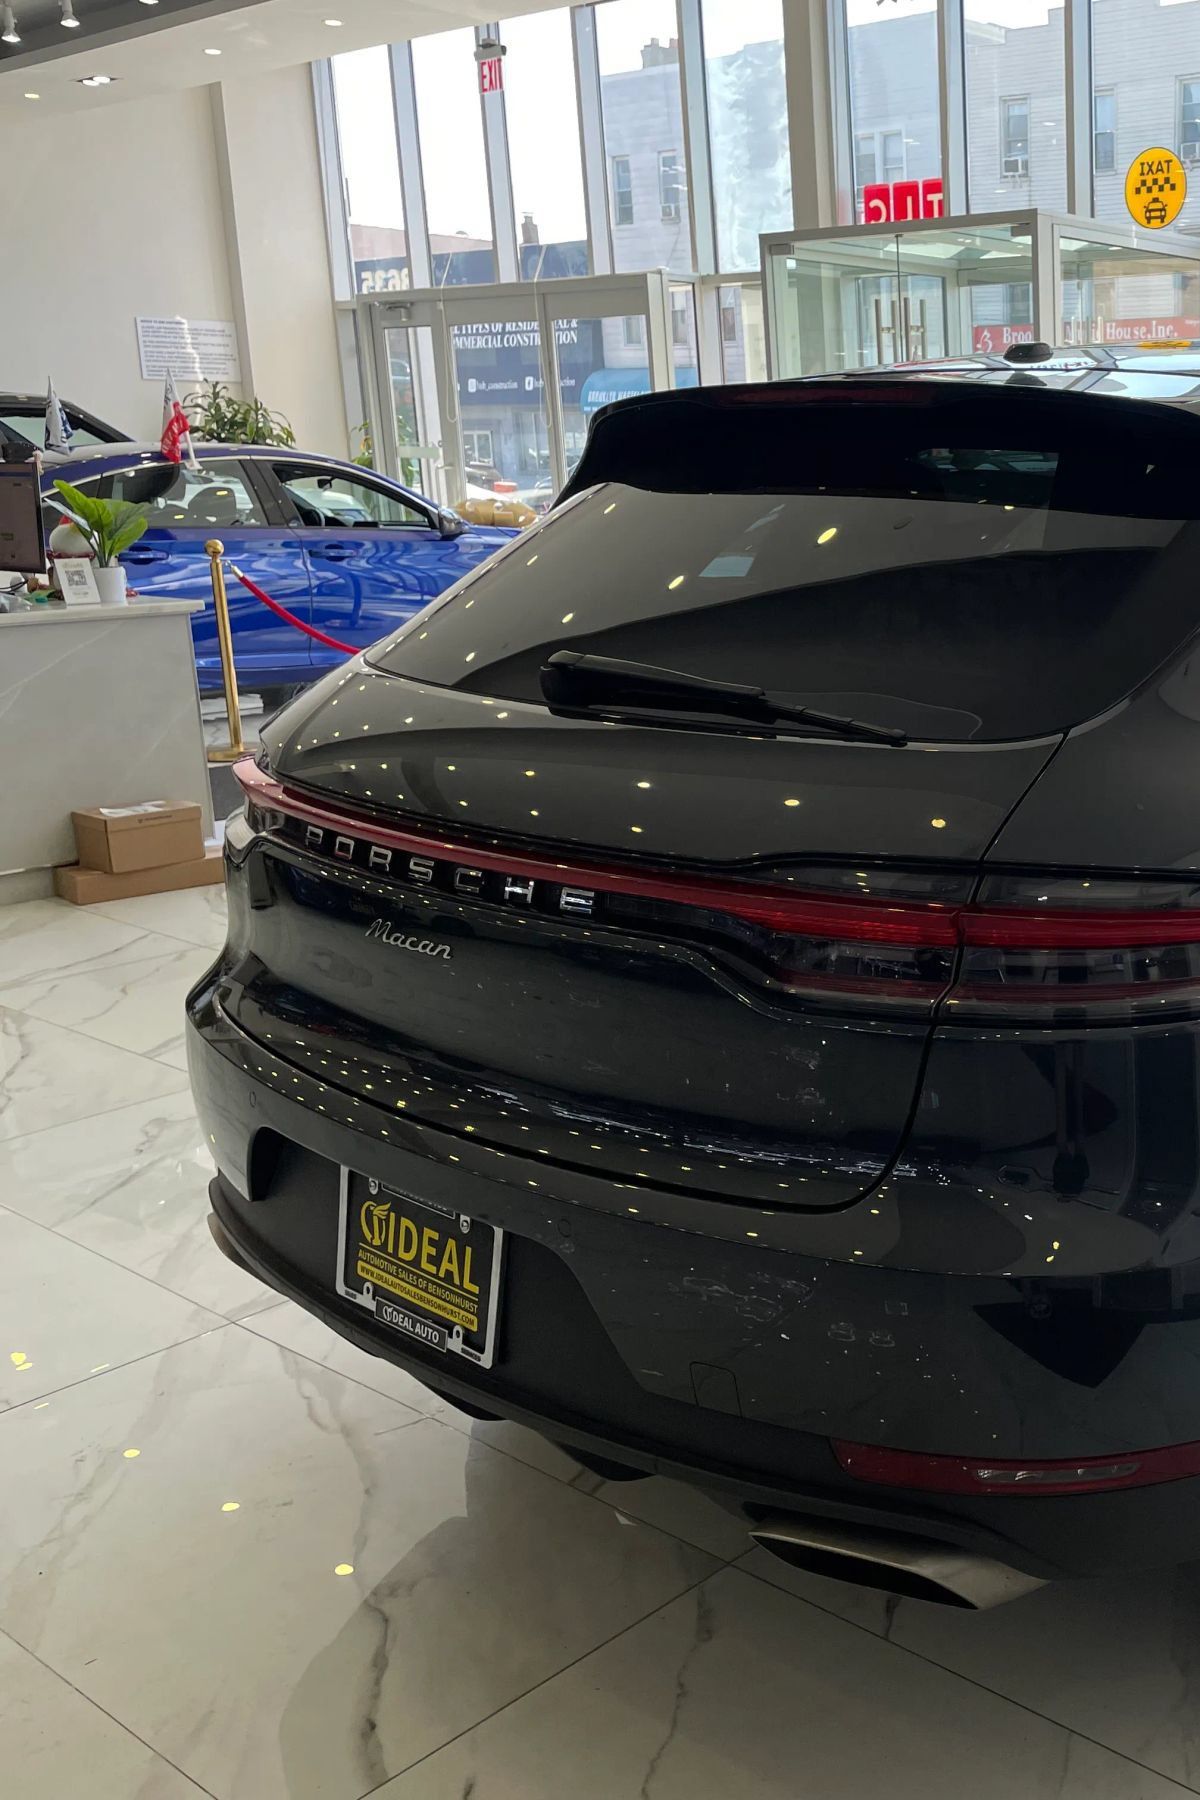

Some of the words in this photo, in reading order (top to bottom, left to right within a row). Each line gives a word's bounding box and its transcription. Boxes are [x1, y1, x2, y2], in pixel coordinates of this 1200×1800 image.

[480, 58, 503, 93] EXIT
[453, 334, 503, 349] MMERCIAL
[305, 825, 596, 915] PORSCHE
[365, 918, 452, 959] Macan
[387, 1211, 480, 1295] IDEAL
[359, 1249, 398, 1276] AUTOMOTIVE
[398, 1269, 417, 1287] SALES
[418, 1278, 427, 1290] OF
[428, 1282, 478, 1314] BENSONHURST
[415, 1319, 440, 1344] AUTO
